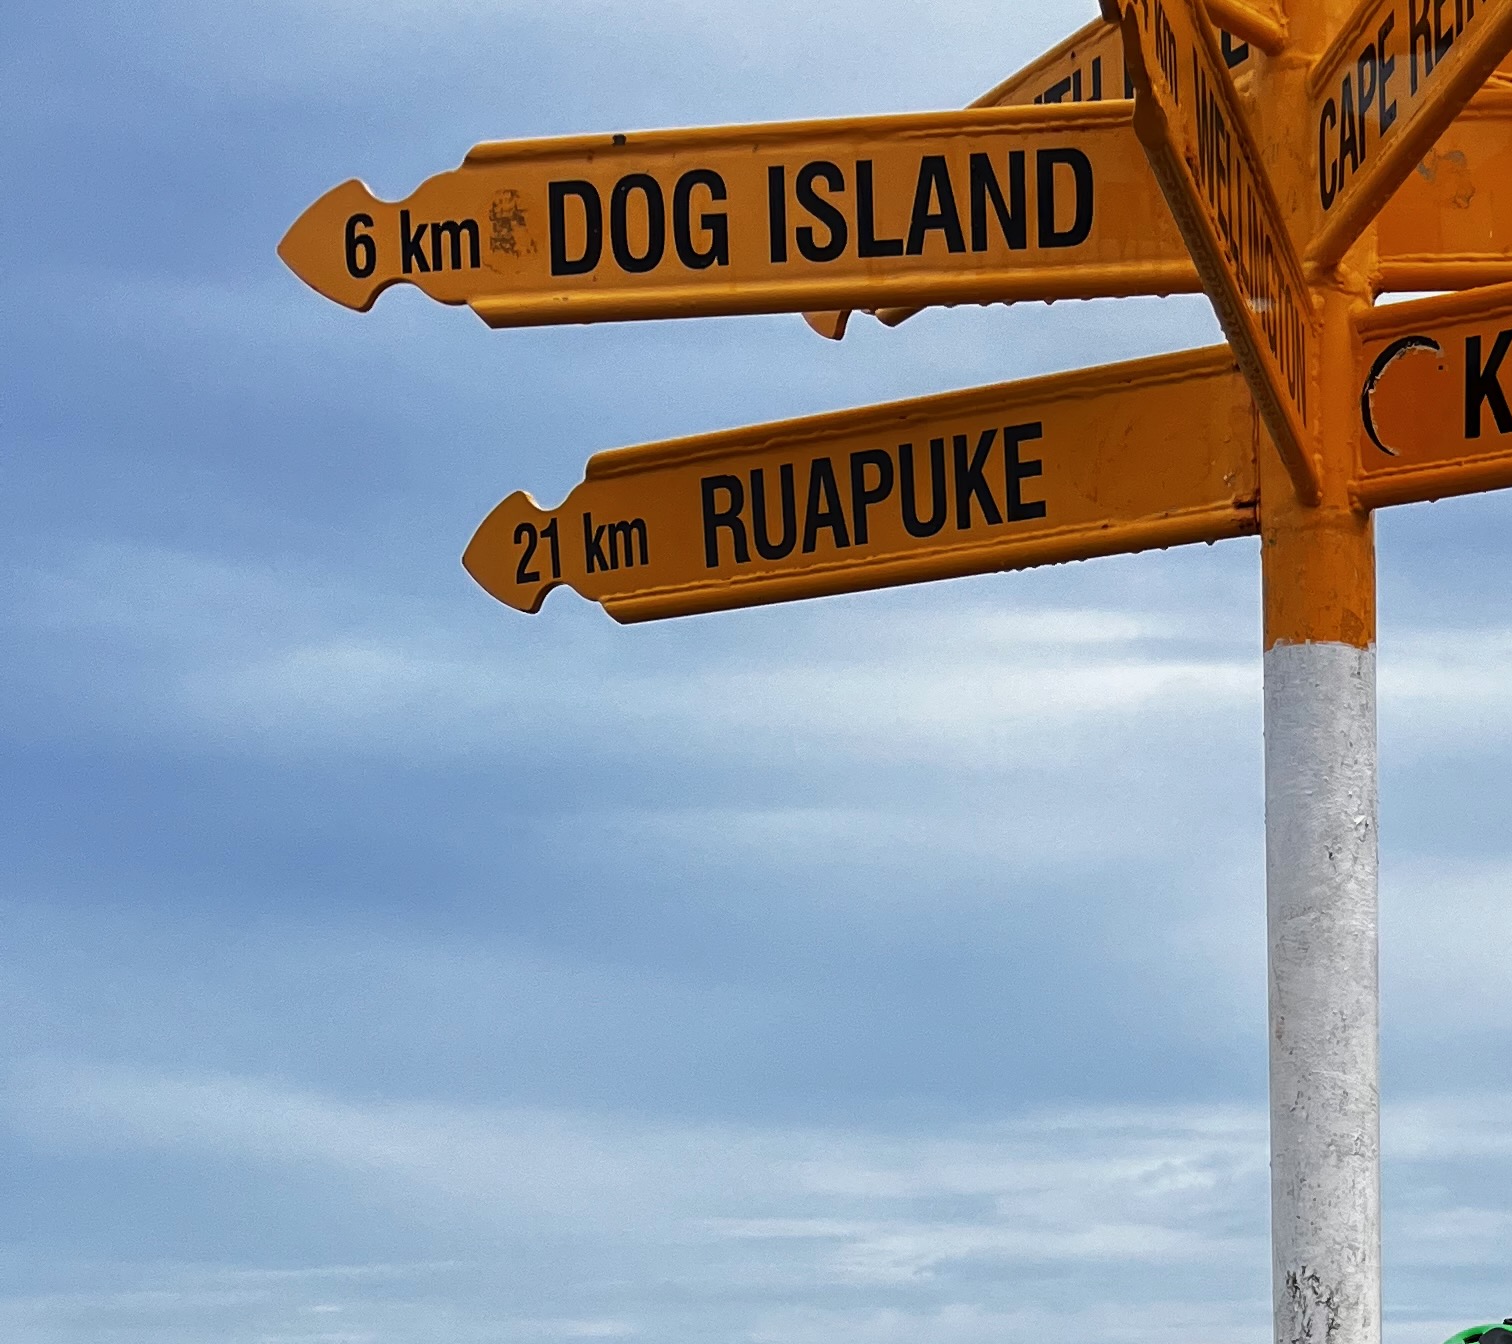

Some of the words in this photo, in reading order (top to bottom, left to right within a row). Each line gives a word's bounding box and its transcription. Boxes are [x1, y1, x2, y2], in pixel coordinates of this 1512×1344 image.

[1319, 9, 1397, 211] CAPE
[345, 213, 376, 279] 6
[400, 209, 481, 274] km
[548, 168, 729, 277] DOG
[769, 147, 1094, 264] ISLAND
[1192, 44, 1307, 428] WELLINGTON
[513, 518, 562, 585] 21
[583, 512, 649, 574] km
[701, 421, 1047, 568] RUAPUKE
